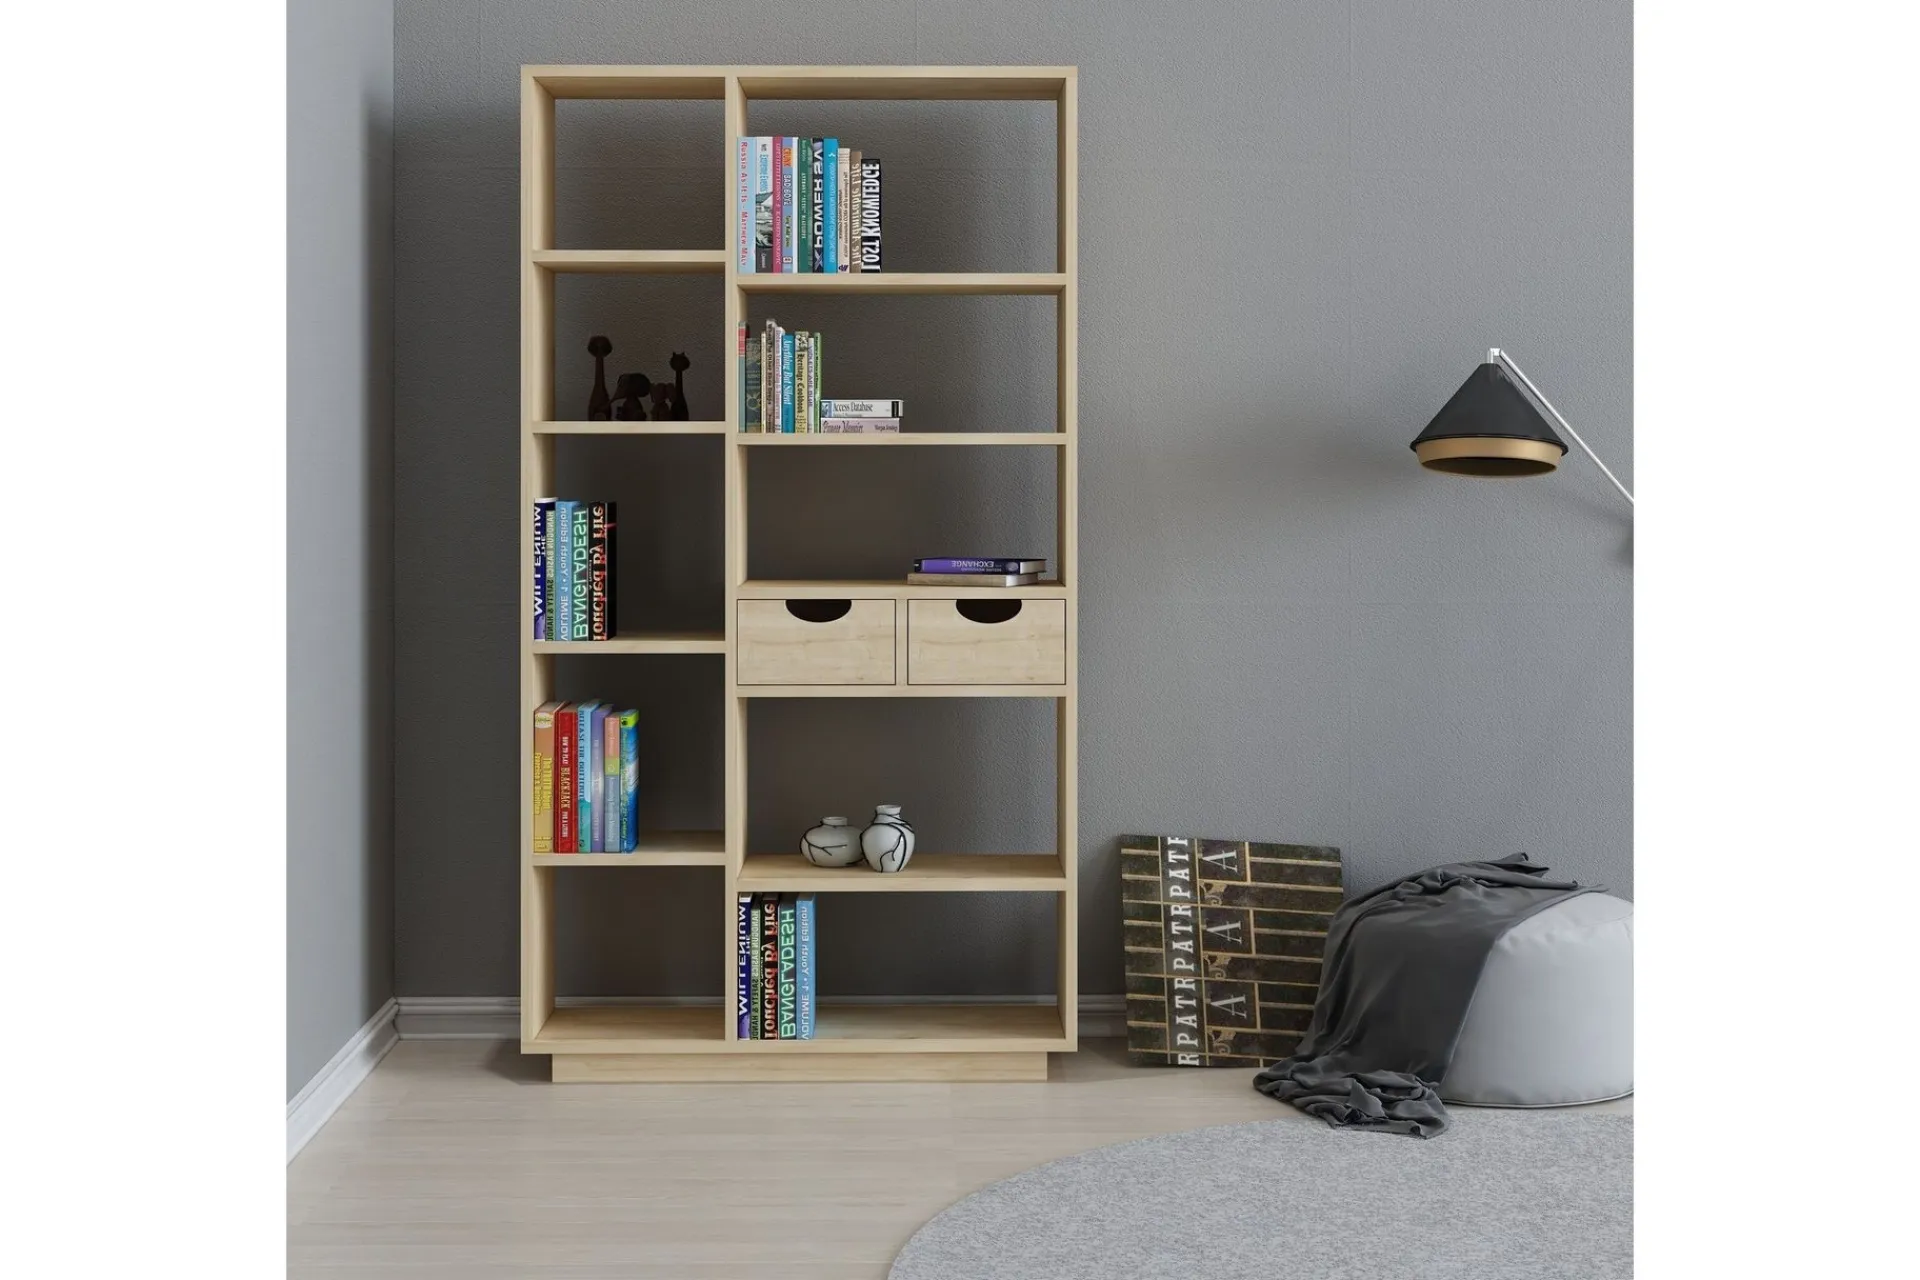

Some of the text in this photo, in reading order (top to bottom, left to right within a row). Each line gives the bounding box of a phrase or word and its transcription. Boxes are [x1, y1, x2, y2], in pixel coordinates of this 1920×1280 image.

[740, 172, 748, 182] As
[783, 340, 792, 405] Anything But Silent
[833, 402, 873, 412] Access Database
[952, 560, 994, 568] EXCHANGE
[560, 767, 570, 808] BLACKJACK
[1202, 850, 1238, 874] A
[1206, 920, 1243, 944] A
[1211, 994, 1247, 1019] A
